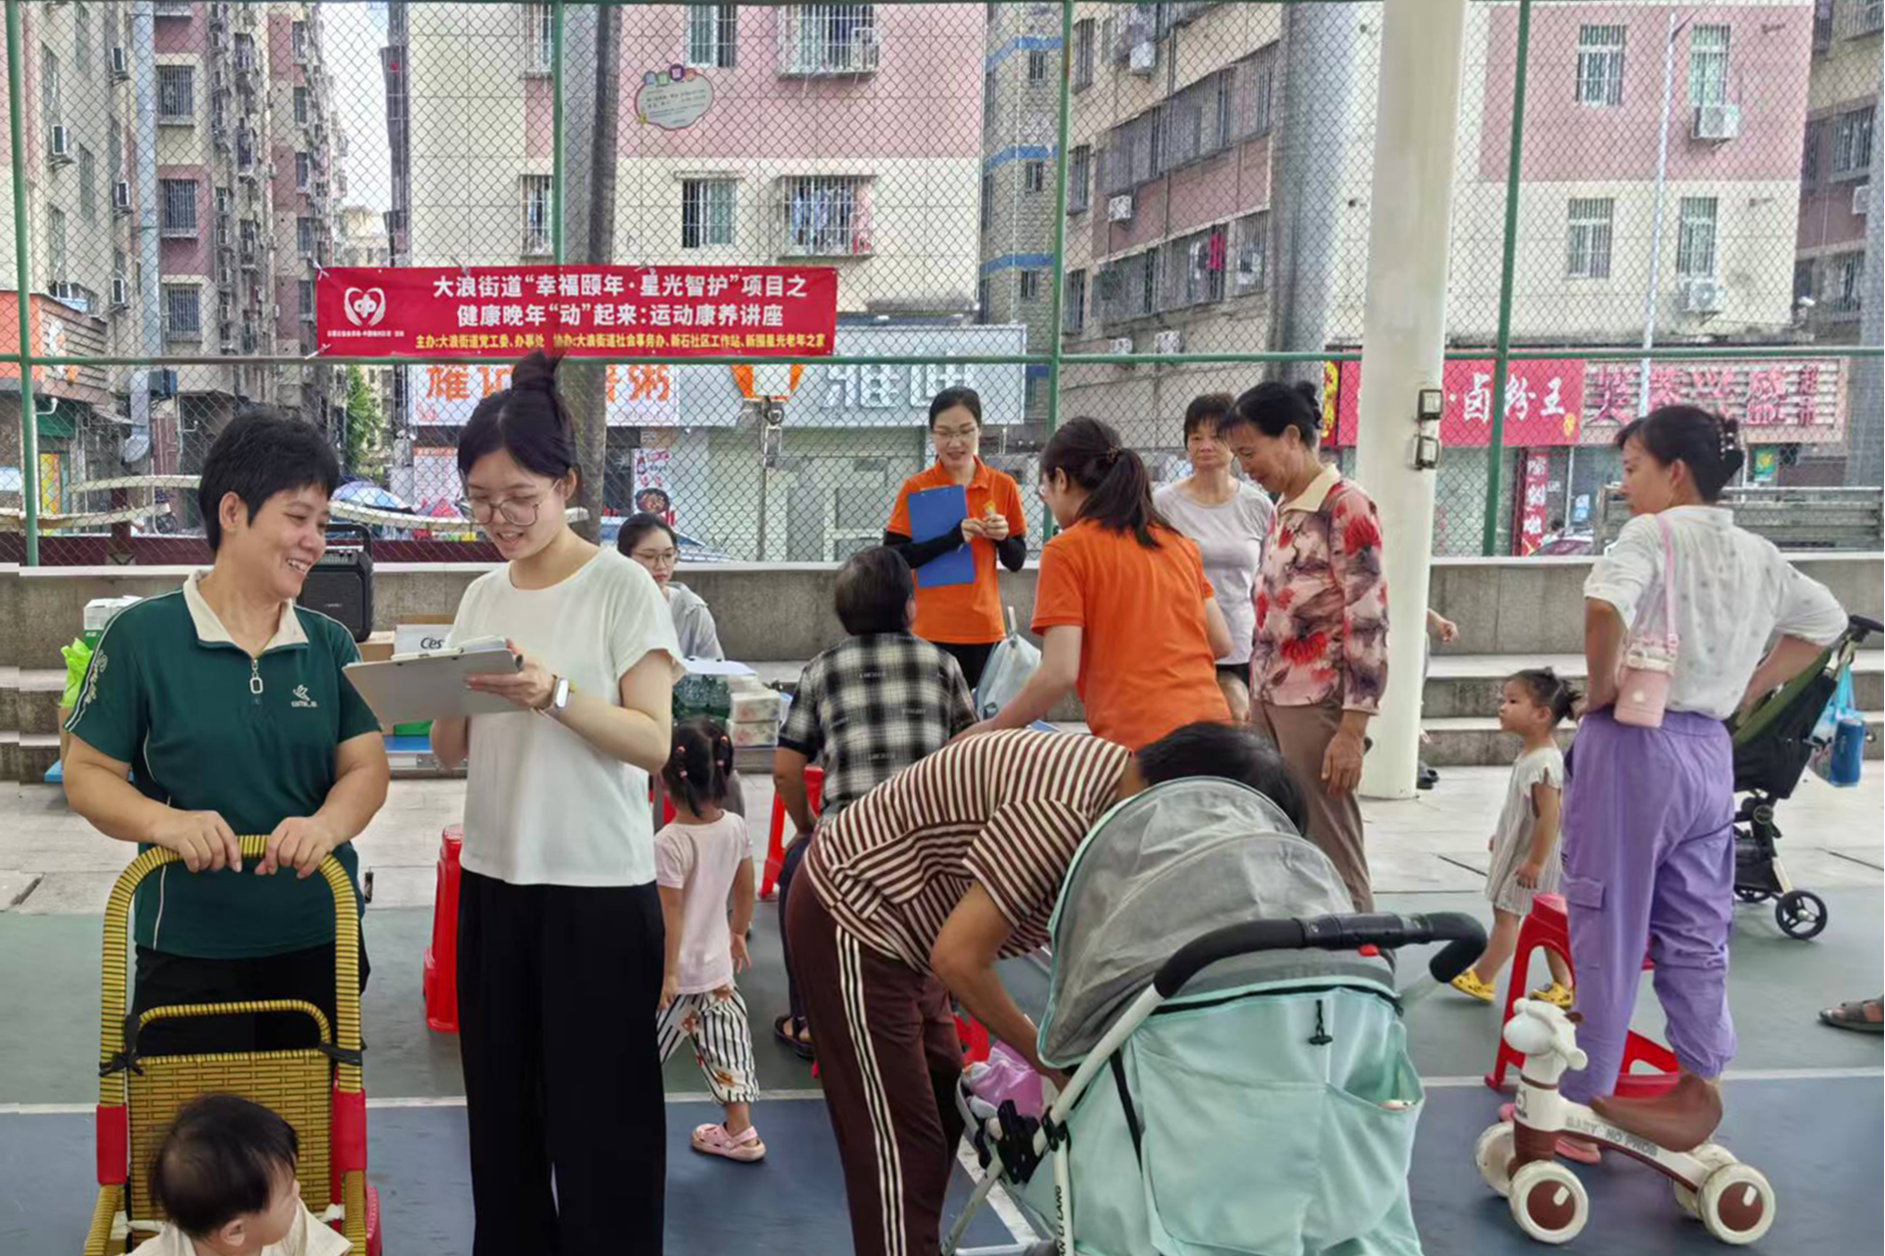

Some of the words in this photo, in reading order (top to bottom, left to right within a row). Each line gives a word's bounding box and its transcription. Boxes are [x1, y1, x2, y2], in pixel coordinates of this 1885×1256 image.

[433, 274, 807, 298] 大浪街道“幸福颐年·星光智护”项目之
[457, 303, 784, 327] 健康晚年“动”起来:运动康养讲座
